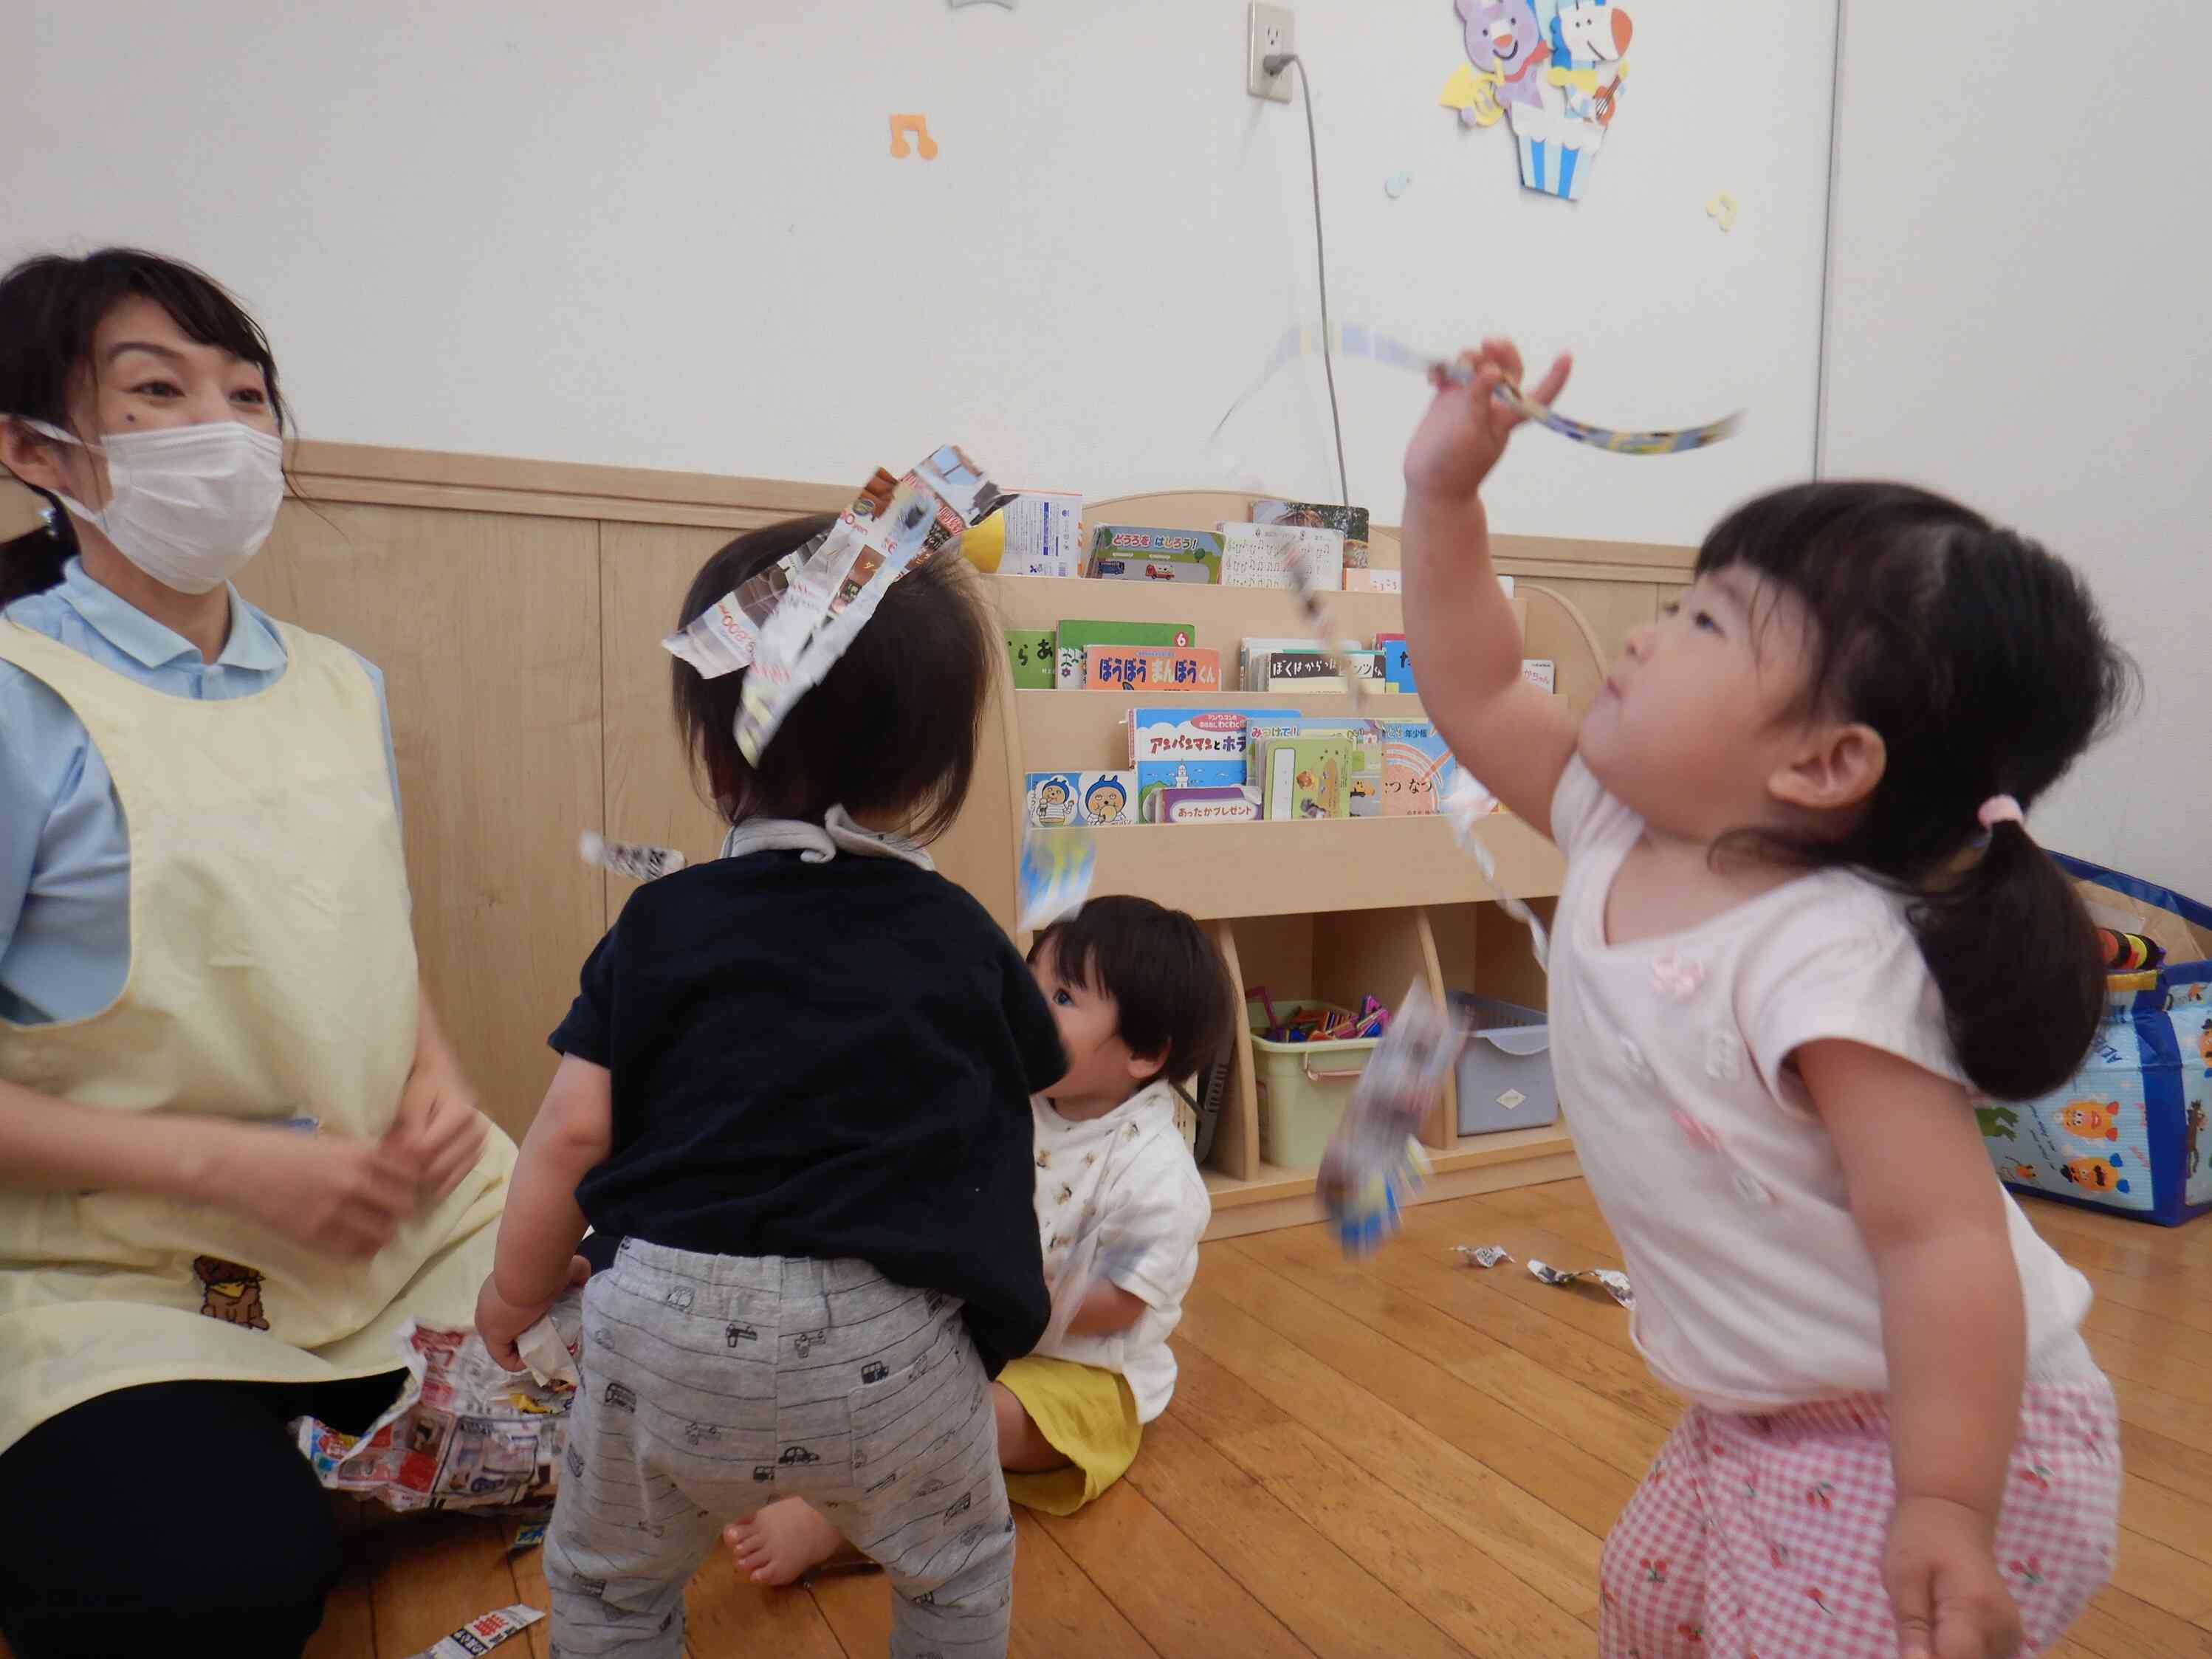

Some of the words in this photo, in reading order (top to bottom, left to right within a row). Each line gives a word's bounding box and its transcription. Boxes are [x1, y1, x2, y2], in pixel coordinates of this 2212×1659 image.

[1113, 534, 1150, 547] どうろを
[1177, 633, 1186, 647] 6
[1178, 806, 1252, 817] あったかプレゼント
